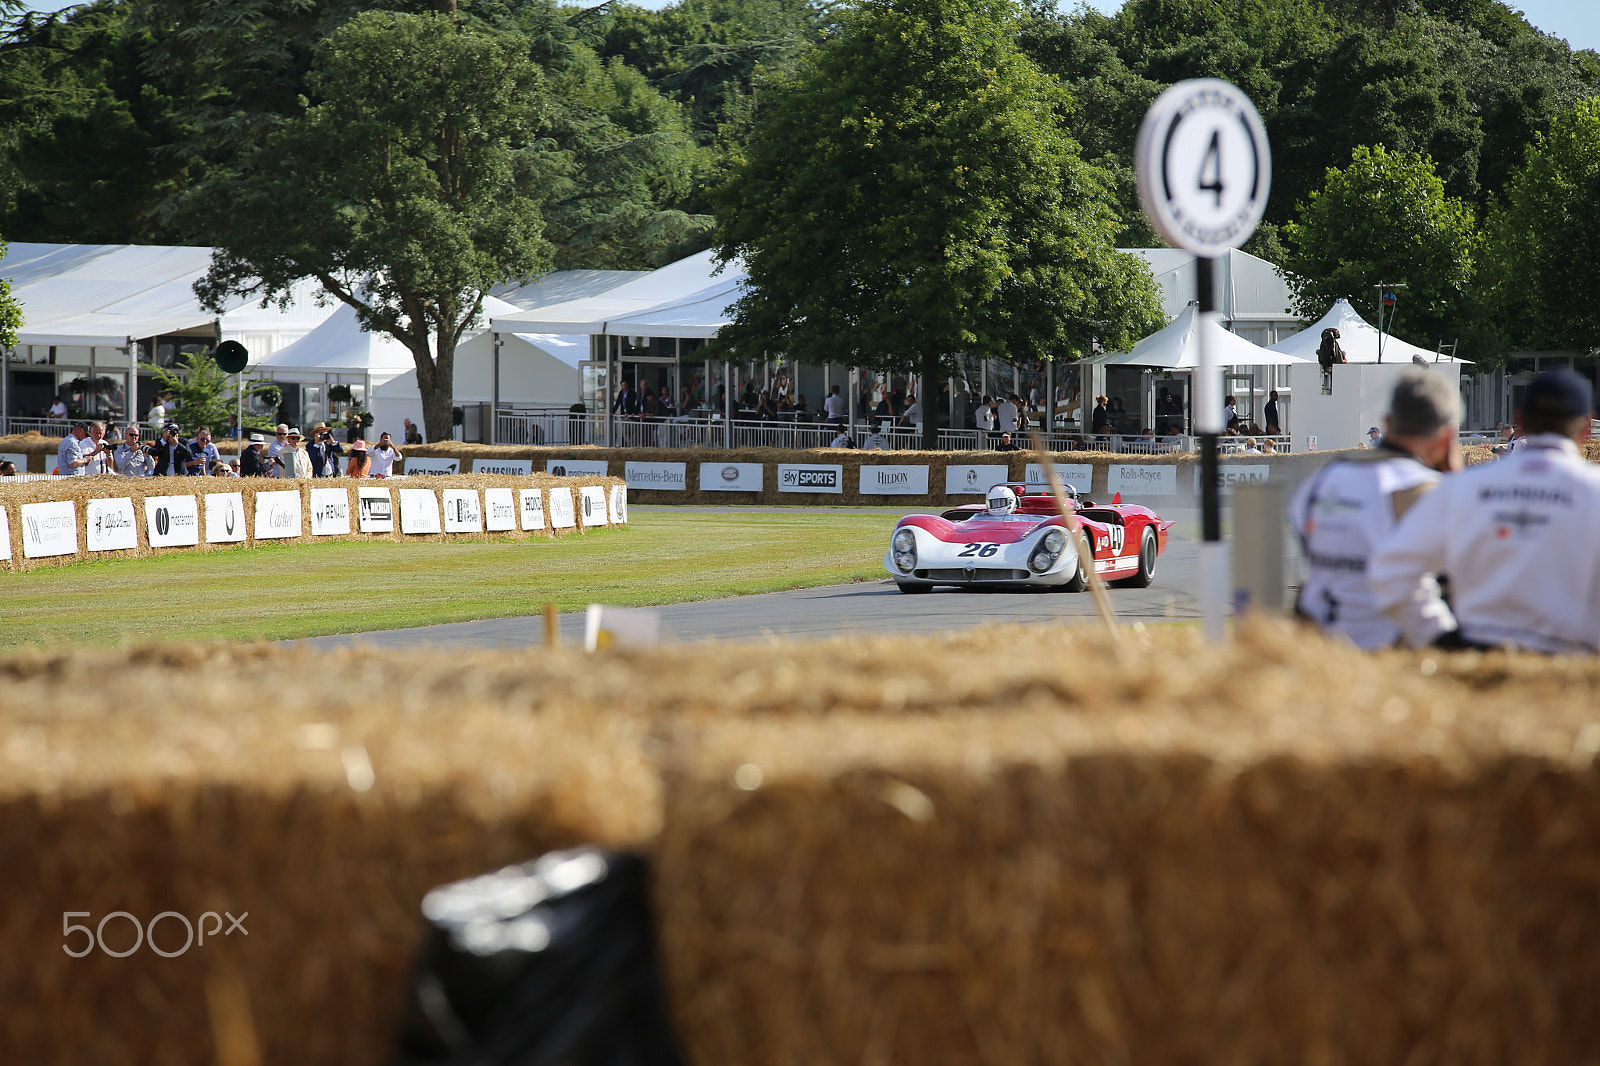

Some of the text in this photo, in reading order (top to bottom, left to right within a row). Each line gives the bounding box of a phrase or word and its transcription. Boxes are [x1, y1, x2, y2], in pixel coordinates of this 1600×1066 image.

[1197, 129, 1225, 209] 4
[480, 466, 523, 476] SAMSUNG
[627, 468, 684, 484] Mercedes-Benz
[783, 470, 836, 486] sky SPORTS
[876, 470, 908, 485] HILDON
[1120, 467, 1162, 482] Rolls-Royce
[269, 502, 294, 528] Cartier
[325, 503, 347, 520] RENAULT
[956, 542, 1002, 558] 26
